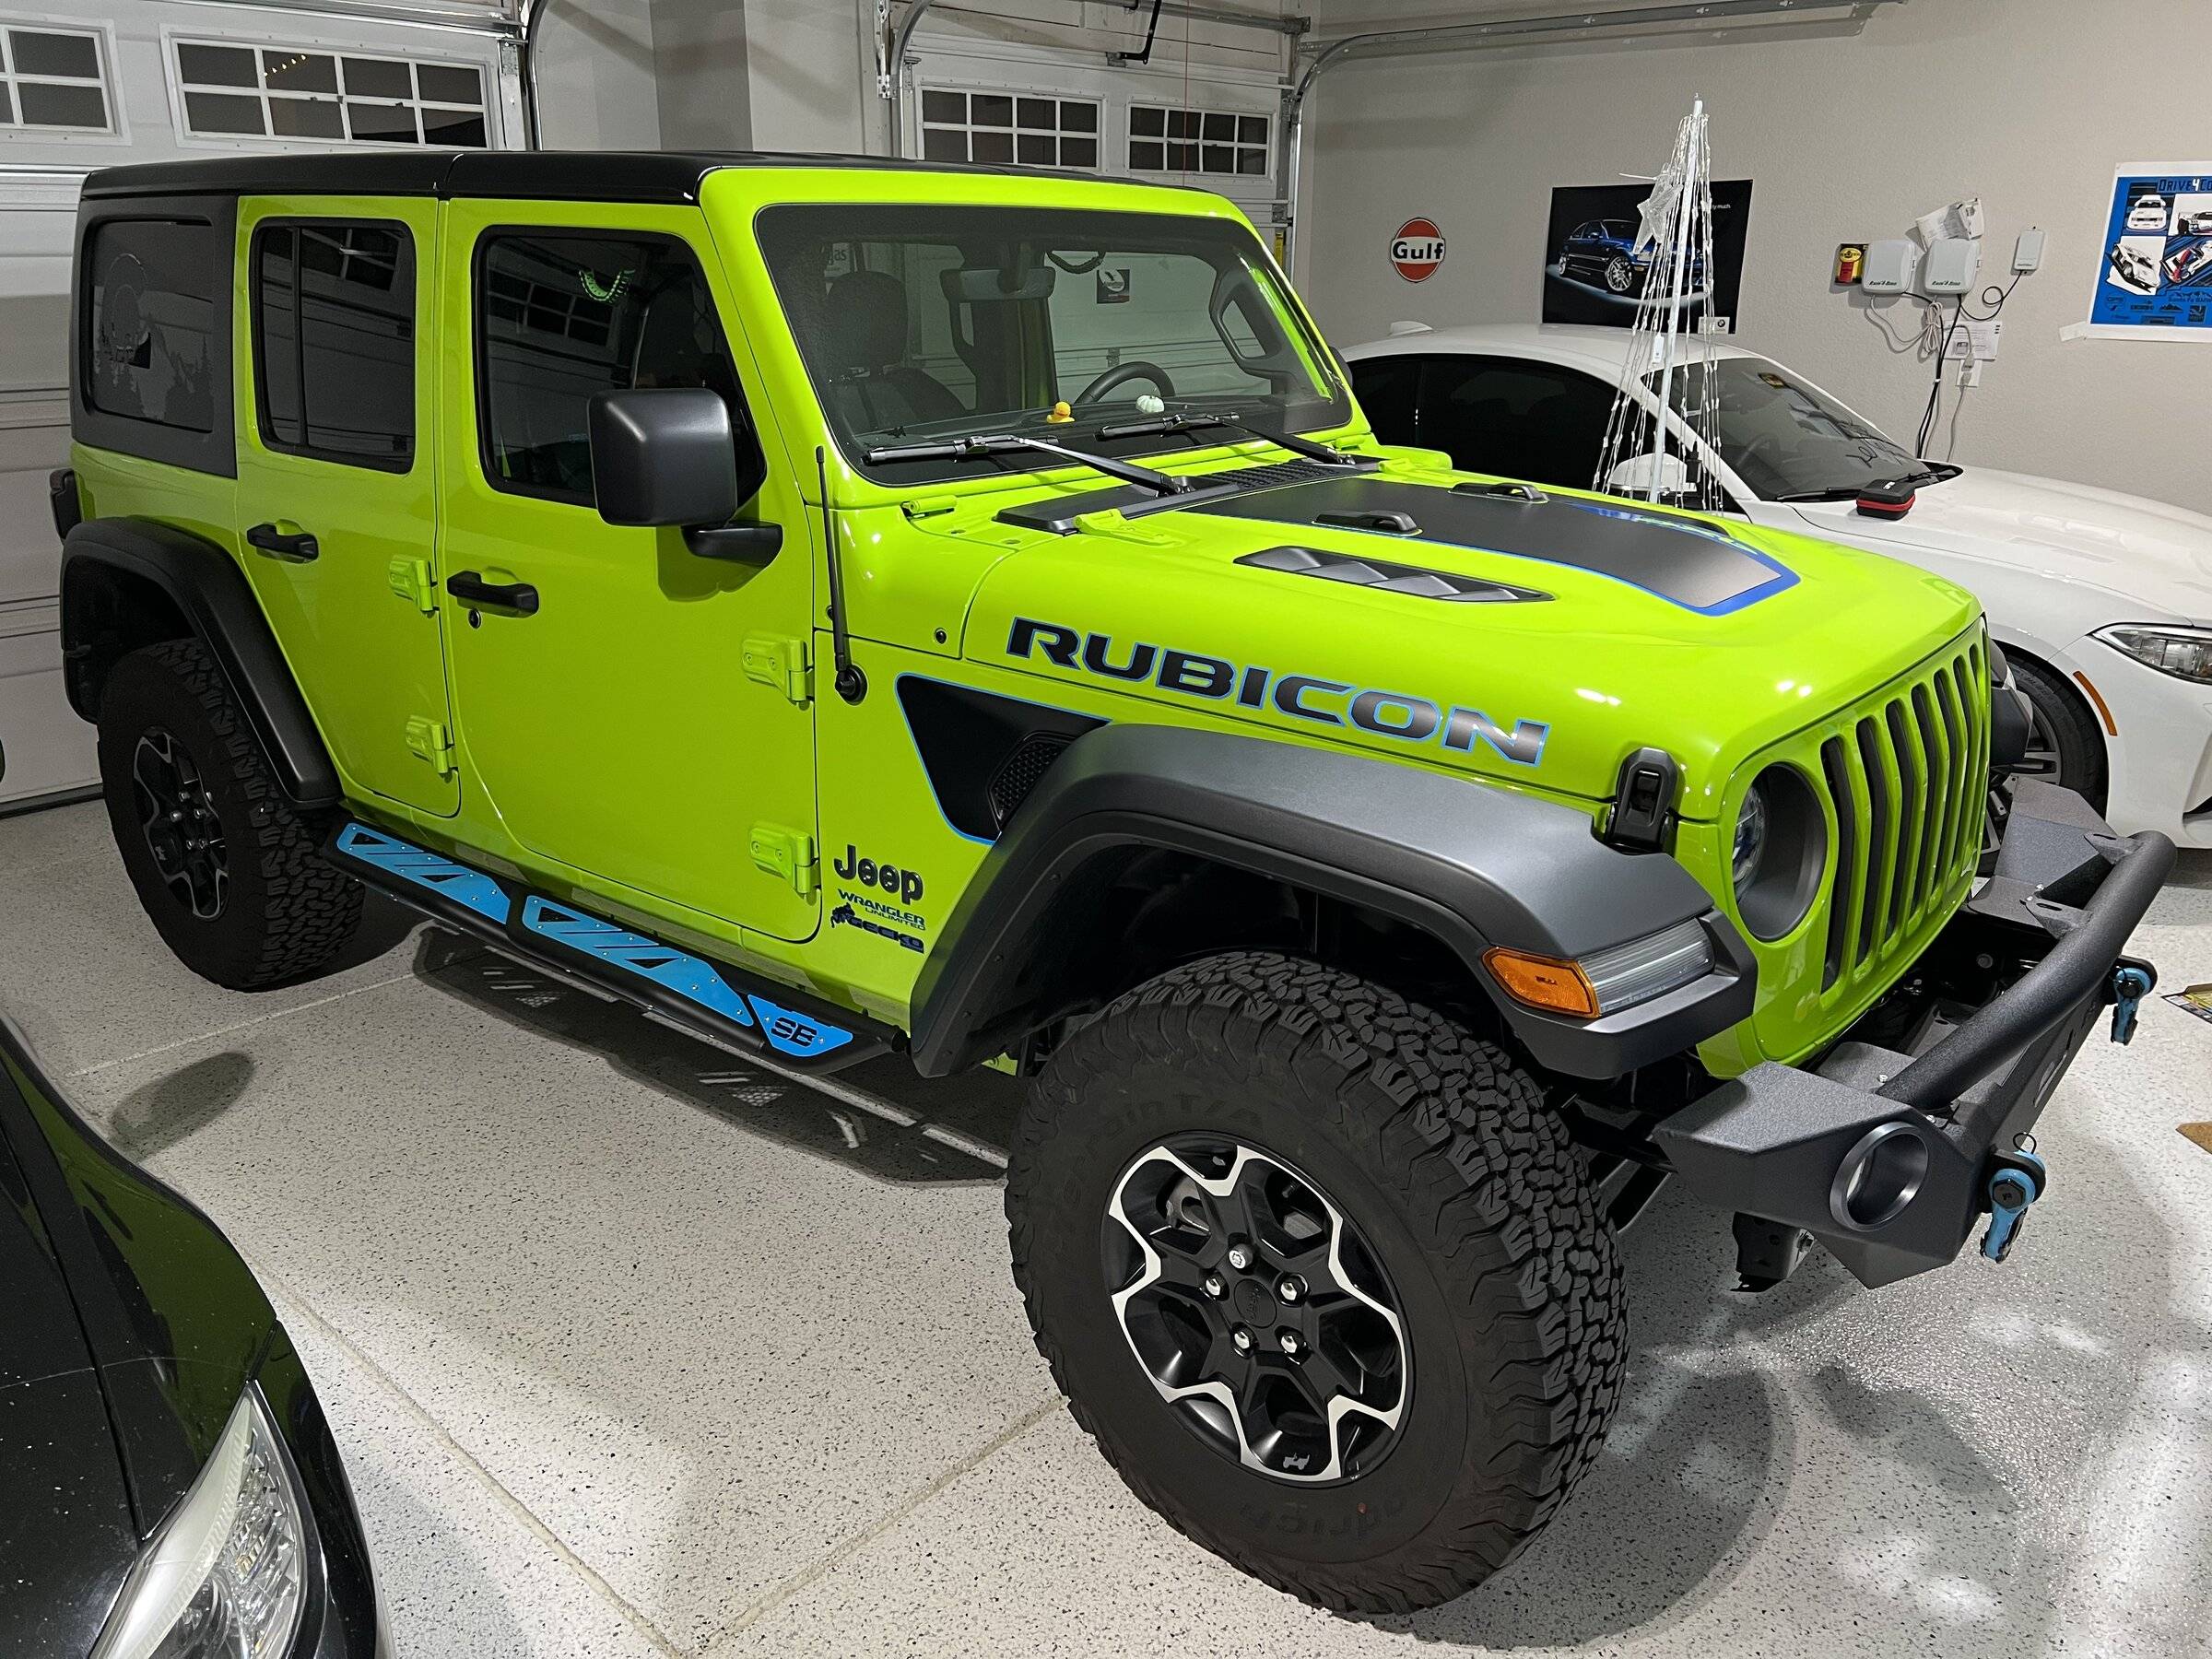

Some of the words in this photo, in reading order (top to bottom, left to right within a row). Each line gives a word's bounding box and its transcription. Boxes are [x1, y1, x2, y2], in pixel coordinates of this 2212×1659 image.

[1393, 241, 1443, 259] Gulf
[1006, 617, 1550, 767] RUBICON
[833, 843, 924, 906] Jeep
[837, 888, 925, 927] WRANGLER
[865, 907, 926, 931] UNLIMITED
